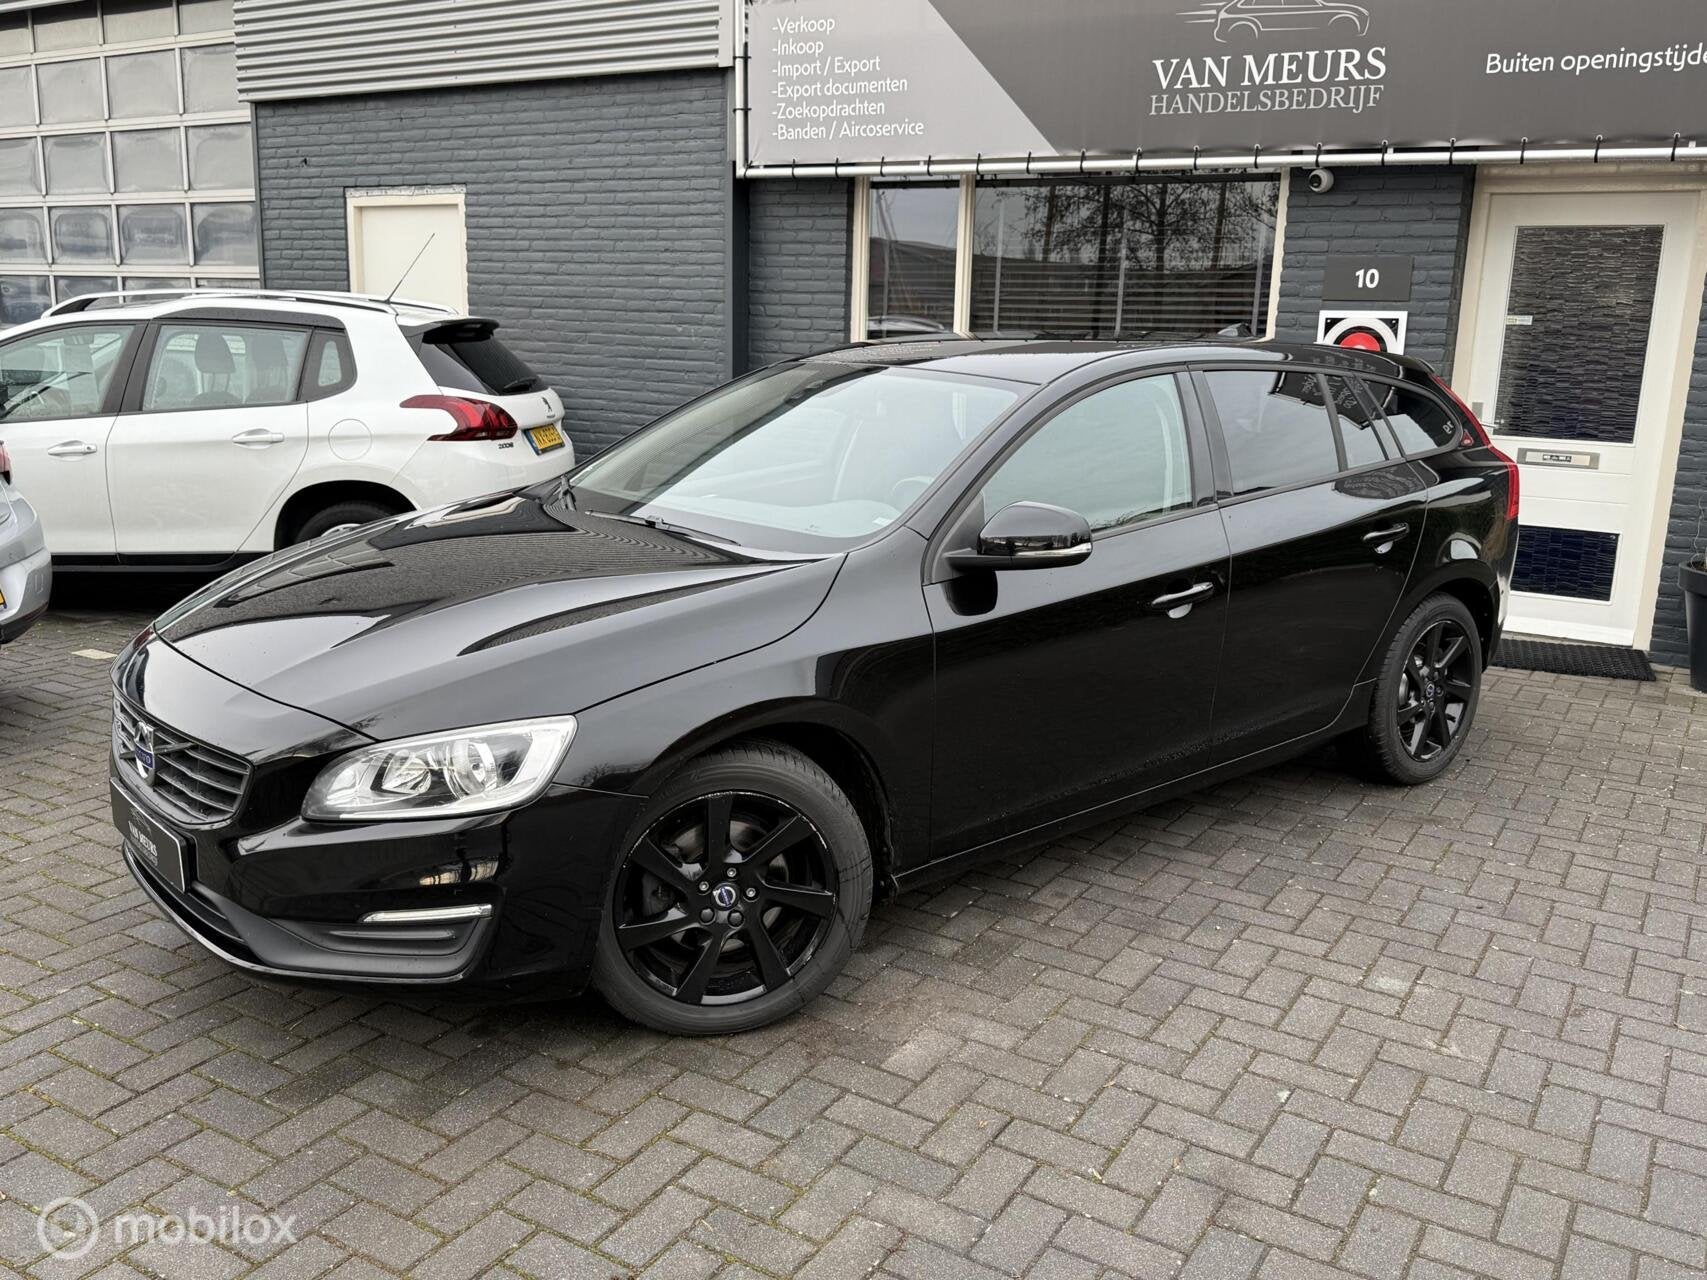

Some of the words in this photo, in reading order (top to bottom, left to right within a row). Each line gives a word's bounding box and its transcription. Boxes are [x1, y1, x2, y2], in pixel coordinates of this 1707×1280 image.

[772, 16, 836, 34] -Verkoop
[772, 38, 825, 56] -Inkoop
[772, 60, 822, 79] -Import
[834, 56, 881, 75] Export
[1152, 56, 1231, 90] VAN
[1240, 47, 1387, 86] MEURS
[1485, 51, 1555, 74] Buiten
[771, 81, 822, 100] -Export
[823, 77, 908, 96] documenten
[1149, 84, 1385, 115] HANDELSBEDRIJF
[772, 100, 885, 121] -Zoekopdrachten
[772, 122, 827, 140] -Banden
[839, 118, 924, 138] Aircoservice
[1356, 268, 1379, 289] 10
